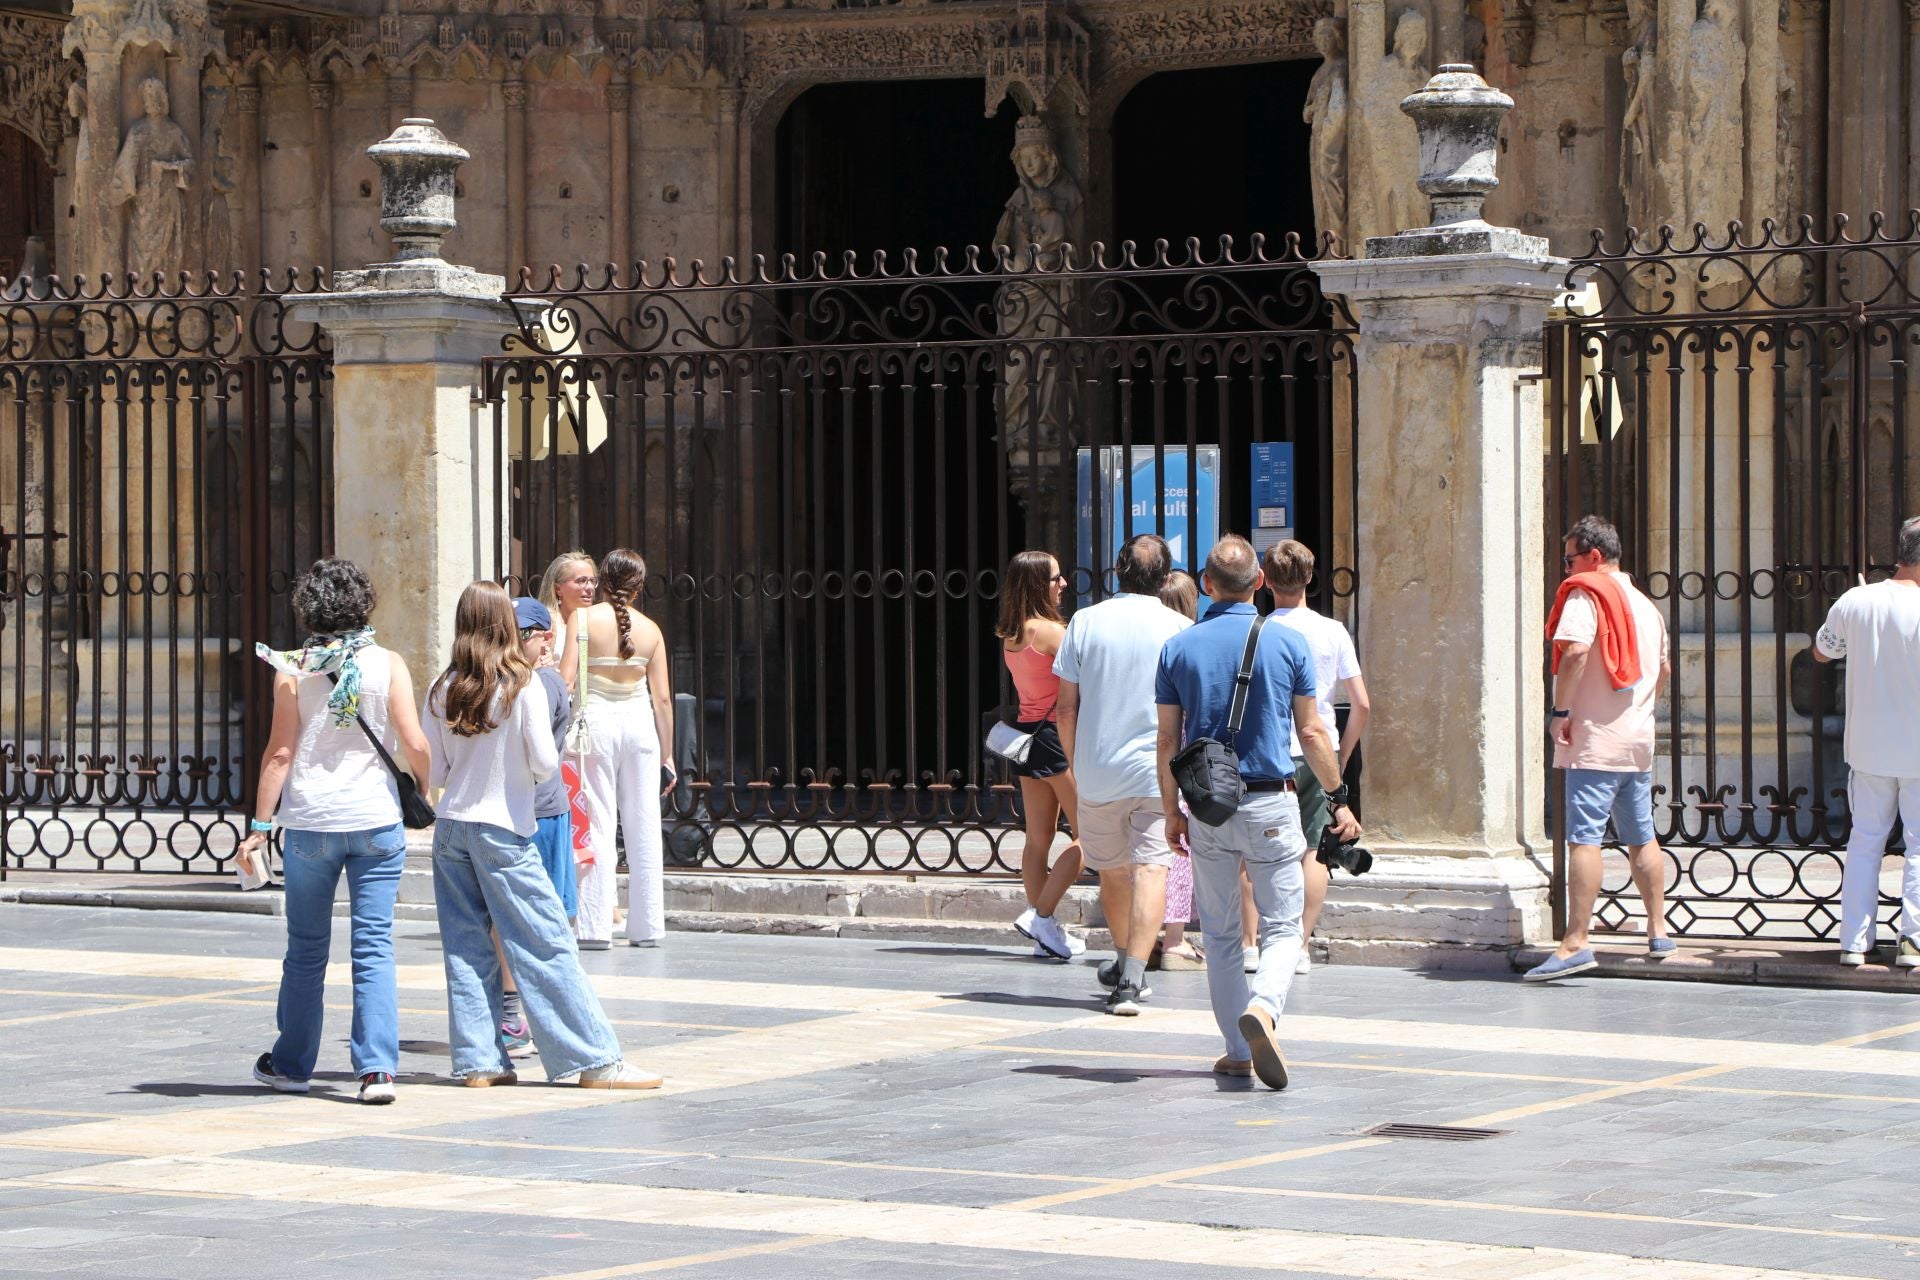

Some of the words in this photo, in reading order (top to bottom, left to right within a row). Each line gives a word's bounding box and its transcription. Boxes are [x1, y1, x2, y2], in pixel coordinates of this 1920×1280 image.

[1154, 487, 1199, 497] cces
[1132, 500, 1146, 516] al
[1152, 500, 1199, 516] ult
